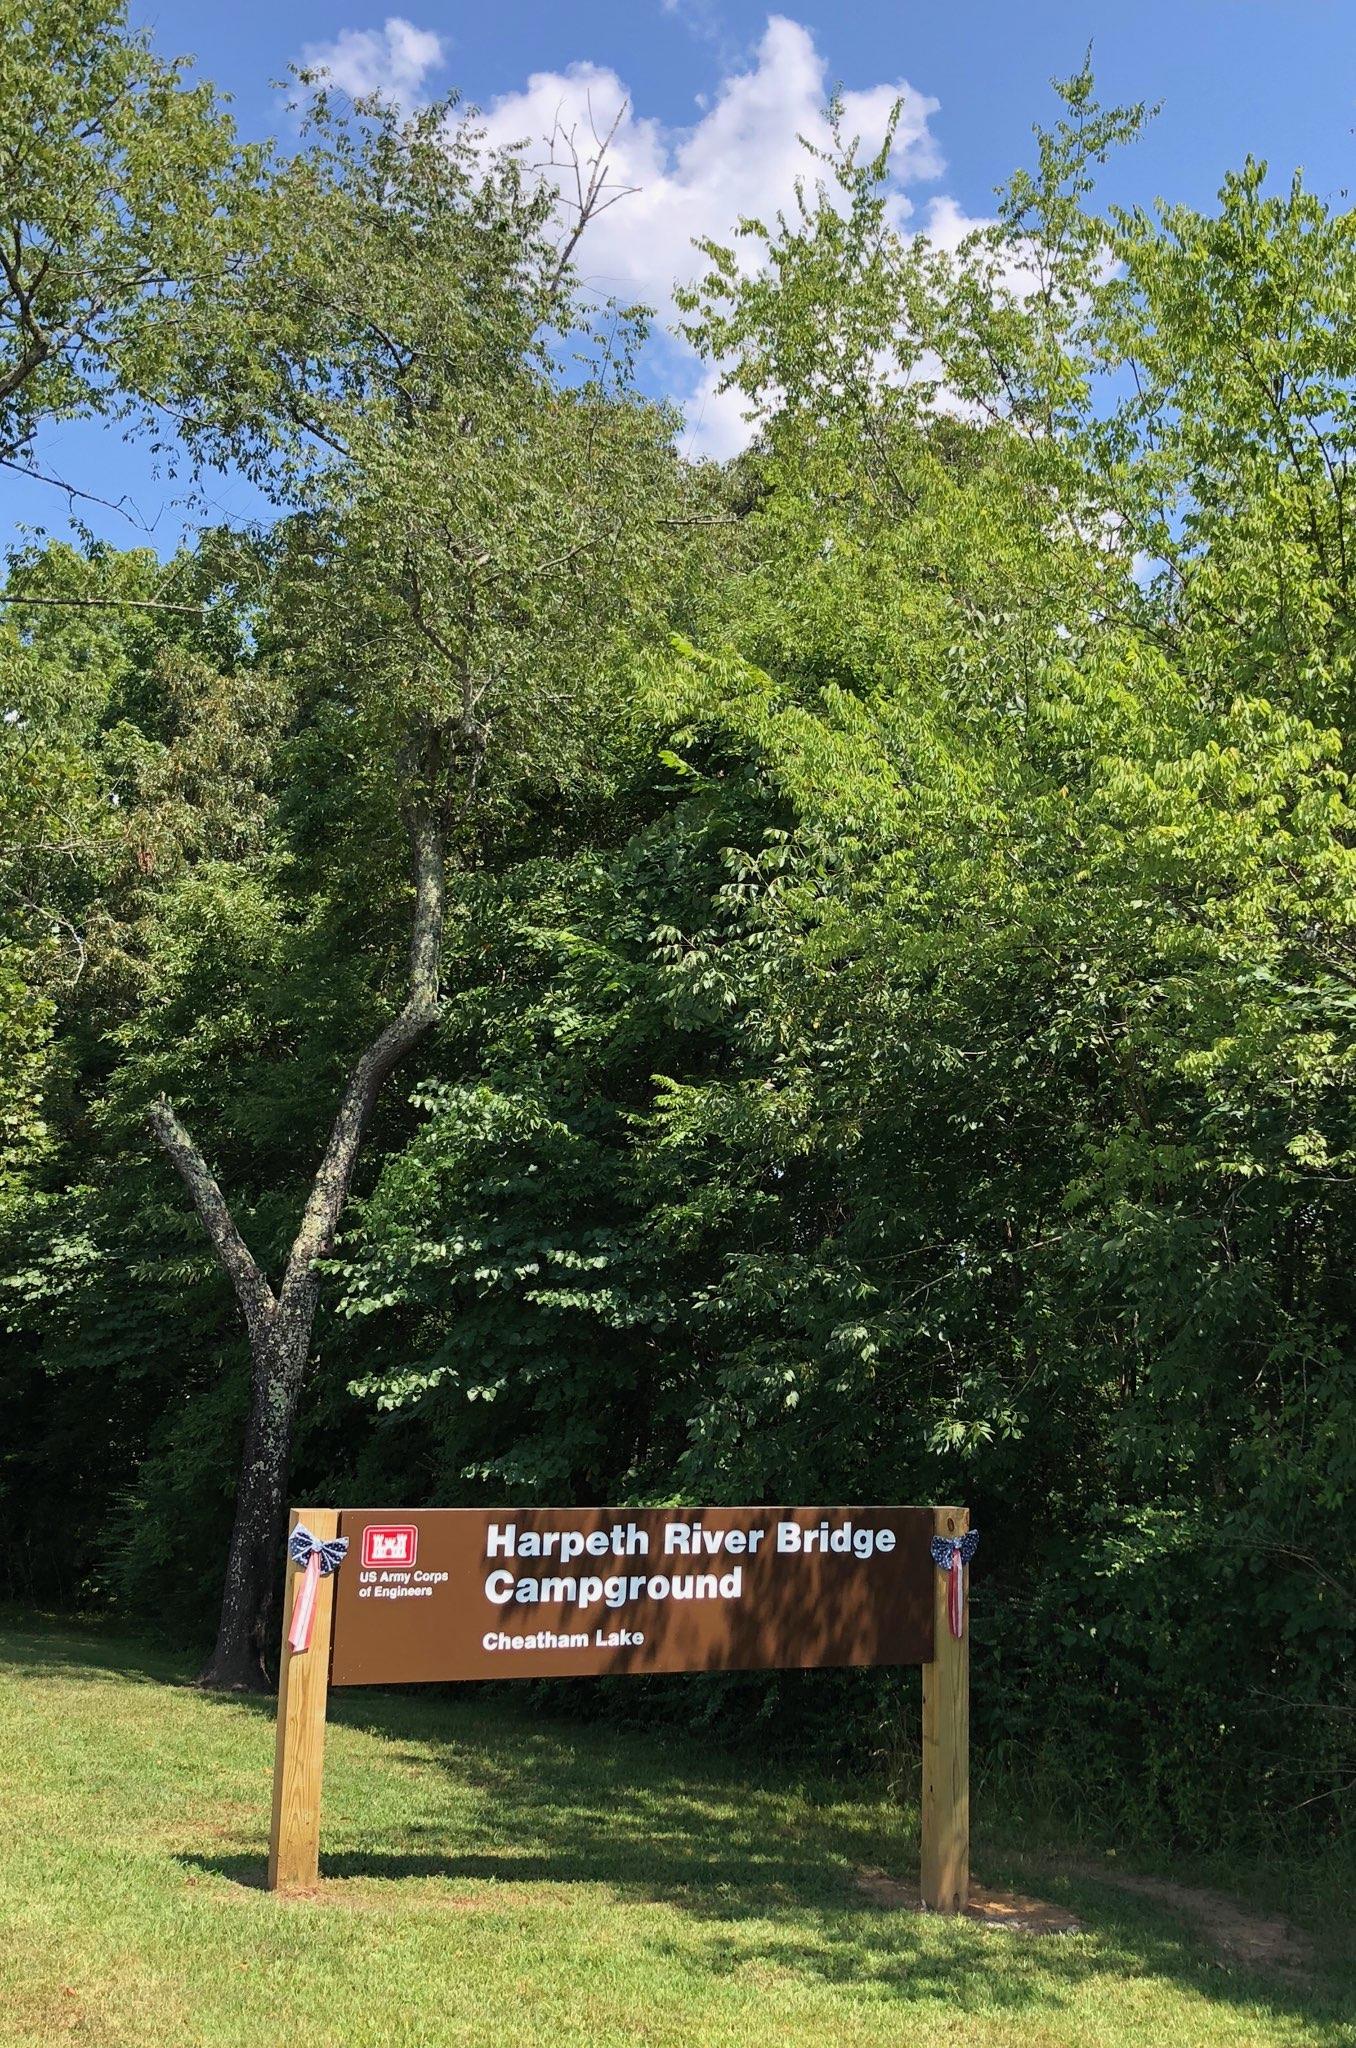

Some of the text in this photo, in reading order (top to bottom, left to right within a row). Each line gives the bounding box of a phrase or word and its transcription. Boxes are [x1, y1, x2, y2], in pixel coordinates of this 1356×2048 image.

[486, 1521, 896, 1563] Harpeth River Bridge
[359, 1570, 449, 1585] US Army Corps
[484, 1566, 742, 1608] Campground
[359, 1585, 433, 1599] of Engineers
[482, 1629, 644, 1650] Cheatham Lake
